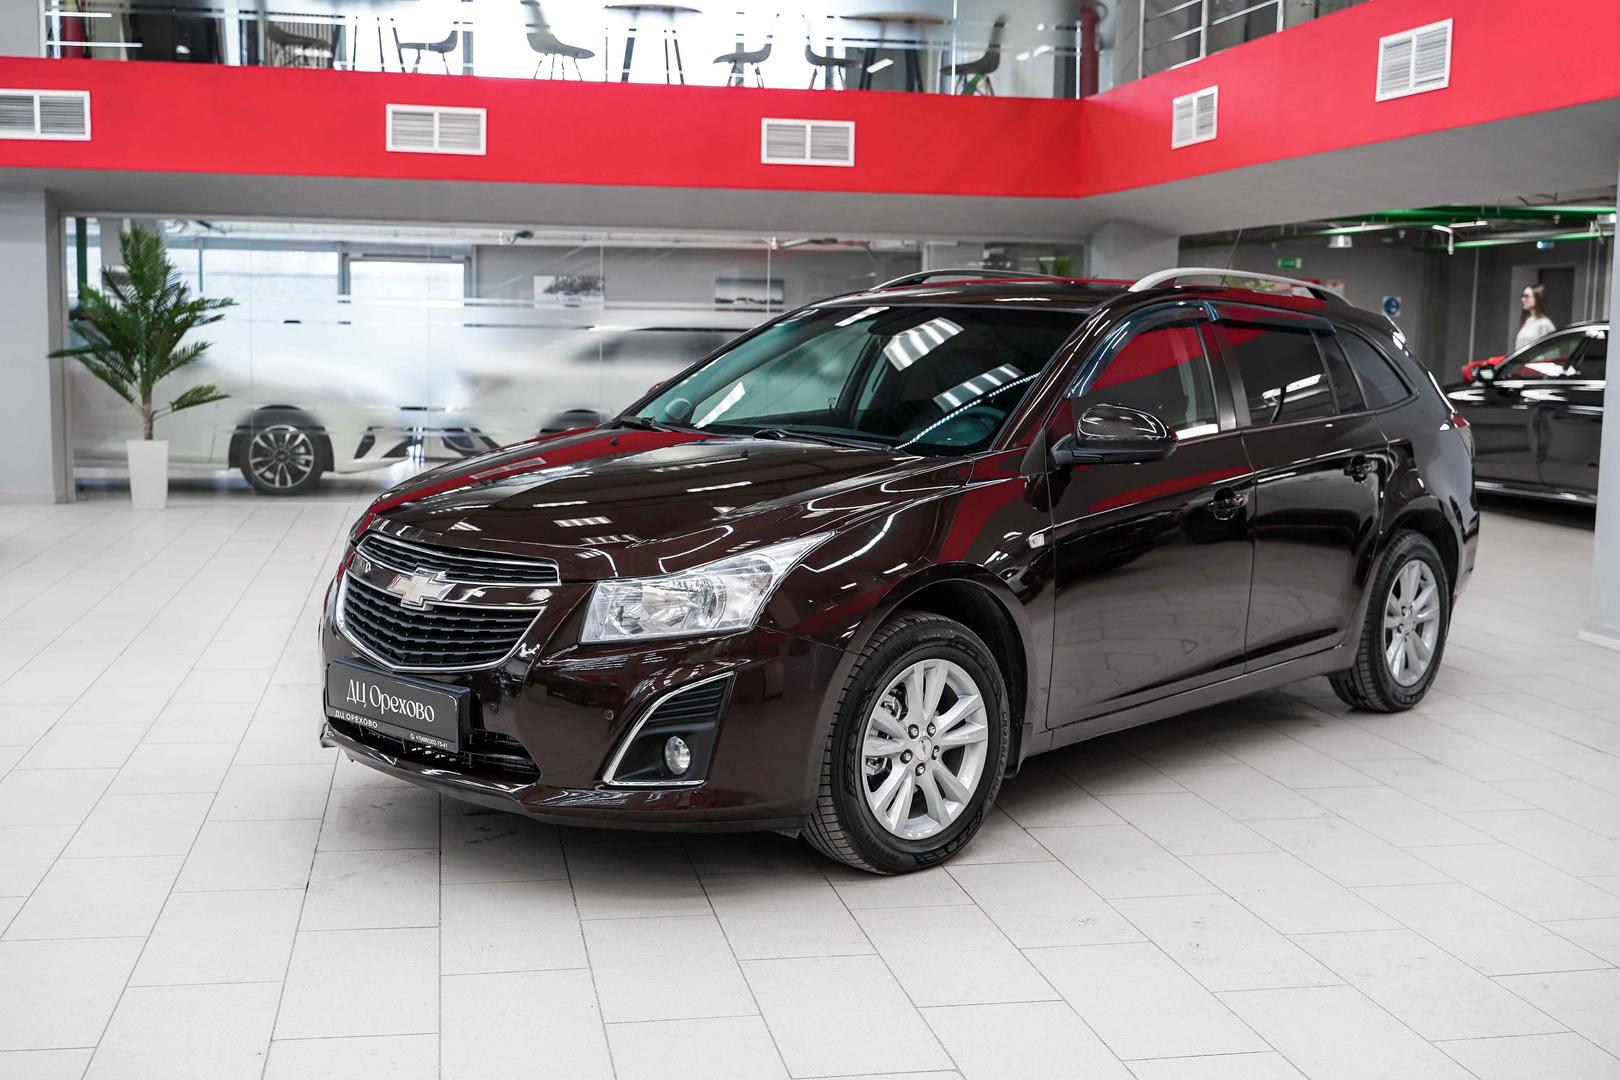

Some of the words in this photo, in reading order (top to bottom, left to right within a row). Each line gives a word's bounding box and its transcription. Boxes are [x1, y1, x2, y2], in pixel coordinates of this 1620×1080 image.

[346, 679, 367, 708] ДЦ
[369, 685, 435, 723] Орехово
[334, 710, 345, 719] ДЦ
[346, 714, 378, 728] ОРЕХОВО
